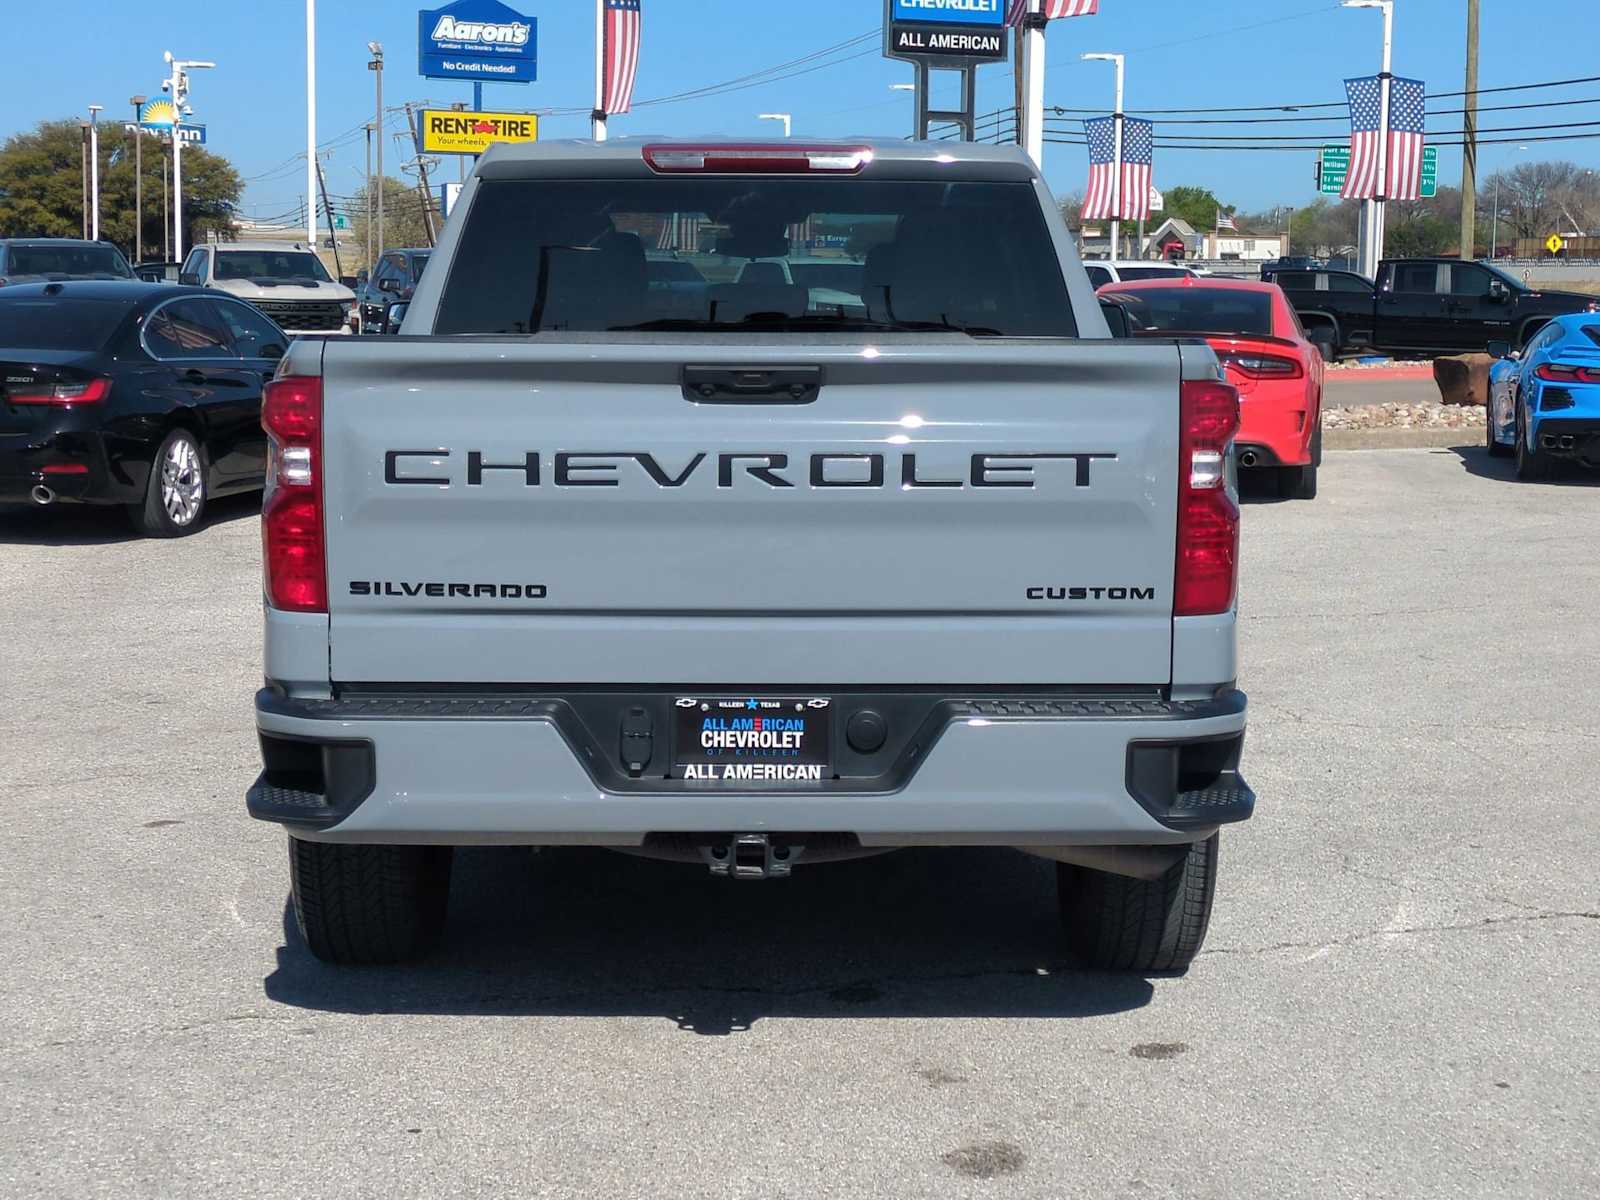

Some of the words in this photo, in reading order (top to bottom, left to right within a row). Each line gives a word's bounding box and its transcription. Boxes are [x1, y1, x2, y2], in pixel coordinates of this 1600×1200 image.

[432, 15, 529, 45] Aaron's
[899, 32, 925, 47] ALL
[929, 34, 1000, 50] AMERICAN
[443, 62, 455, 70] No
[456, 63, 480, 71] Credit
[482, 64, 516, 73] Needed!
[431, 117, 479, 134] RENT
[490, 119, 531, 137] TIRE
[438, 137, 455, 145] Your
[385, 450, 1118, 488] CHEVROLET
[349, 581, 547, 598] SILVERADO
[1026, 587, 1154, 600] CUSTOM
[703, 718, 728, 730] ALL
[731, 717, 804, 731] AMERICAN
[701, 731, 804, 748] CHEVROLET
[684, 764, 719, 779] ALL
[722, 764, 821, 779] AMERICAN
